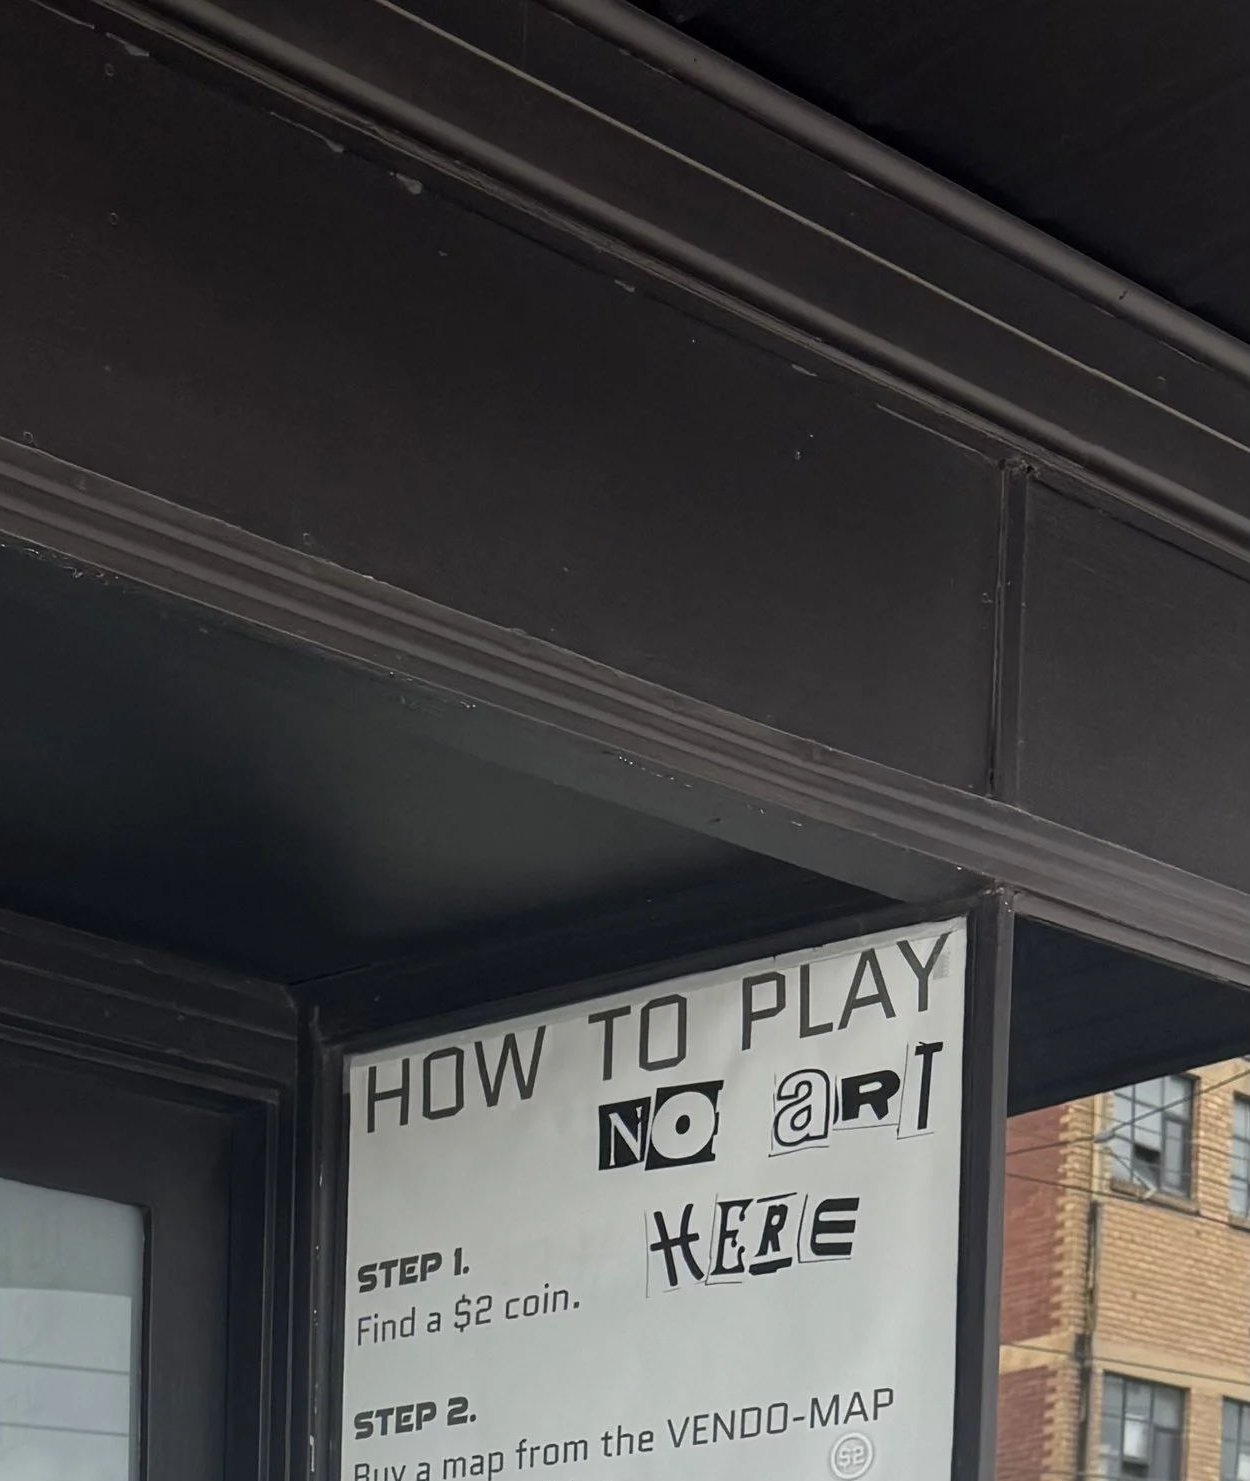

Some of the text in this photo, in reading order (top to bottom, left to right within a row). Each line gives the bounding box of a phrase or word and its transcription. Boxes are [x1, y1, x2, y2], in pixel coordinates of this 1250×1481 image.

[367, 932, 949, 1133] HOW TO PLAY
[598, 1080, 724, 1170] NO
[356, 1246, 470, 1294] STEP 1.
[649, 1193, 860, 1287] HERE
[357, 1282, 580, 1346] Find a $2 coin.
[353, 1395, 477, 1440] STEP 2.
[442, 1450, 504, 1481] map
[514, 1437, 588, 1470] from
[600, 1424, 654, 1458] the
[666, 1387, 894, 1448] VENDO-MAP
